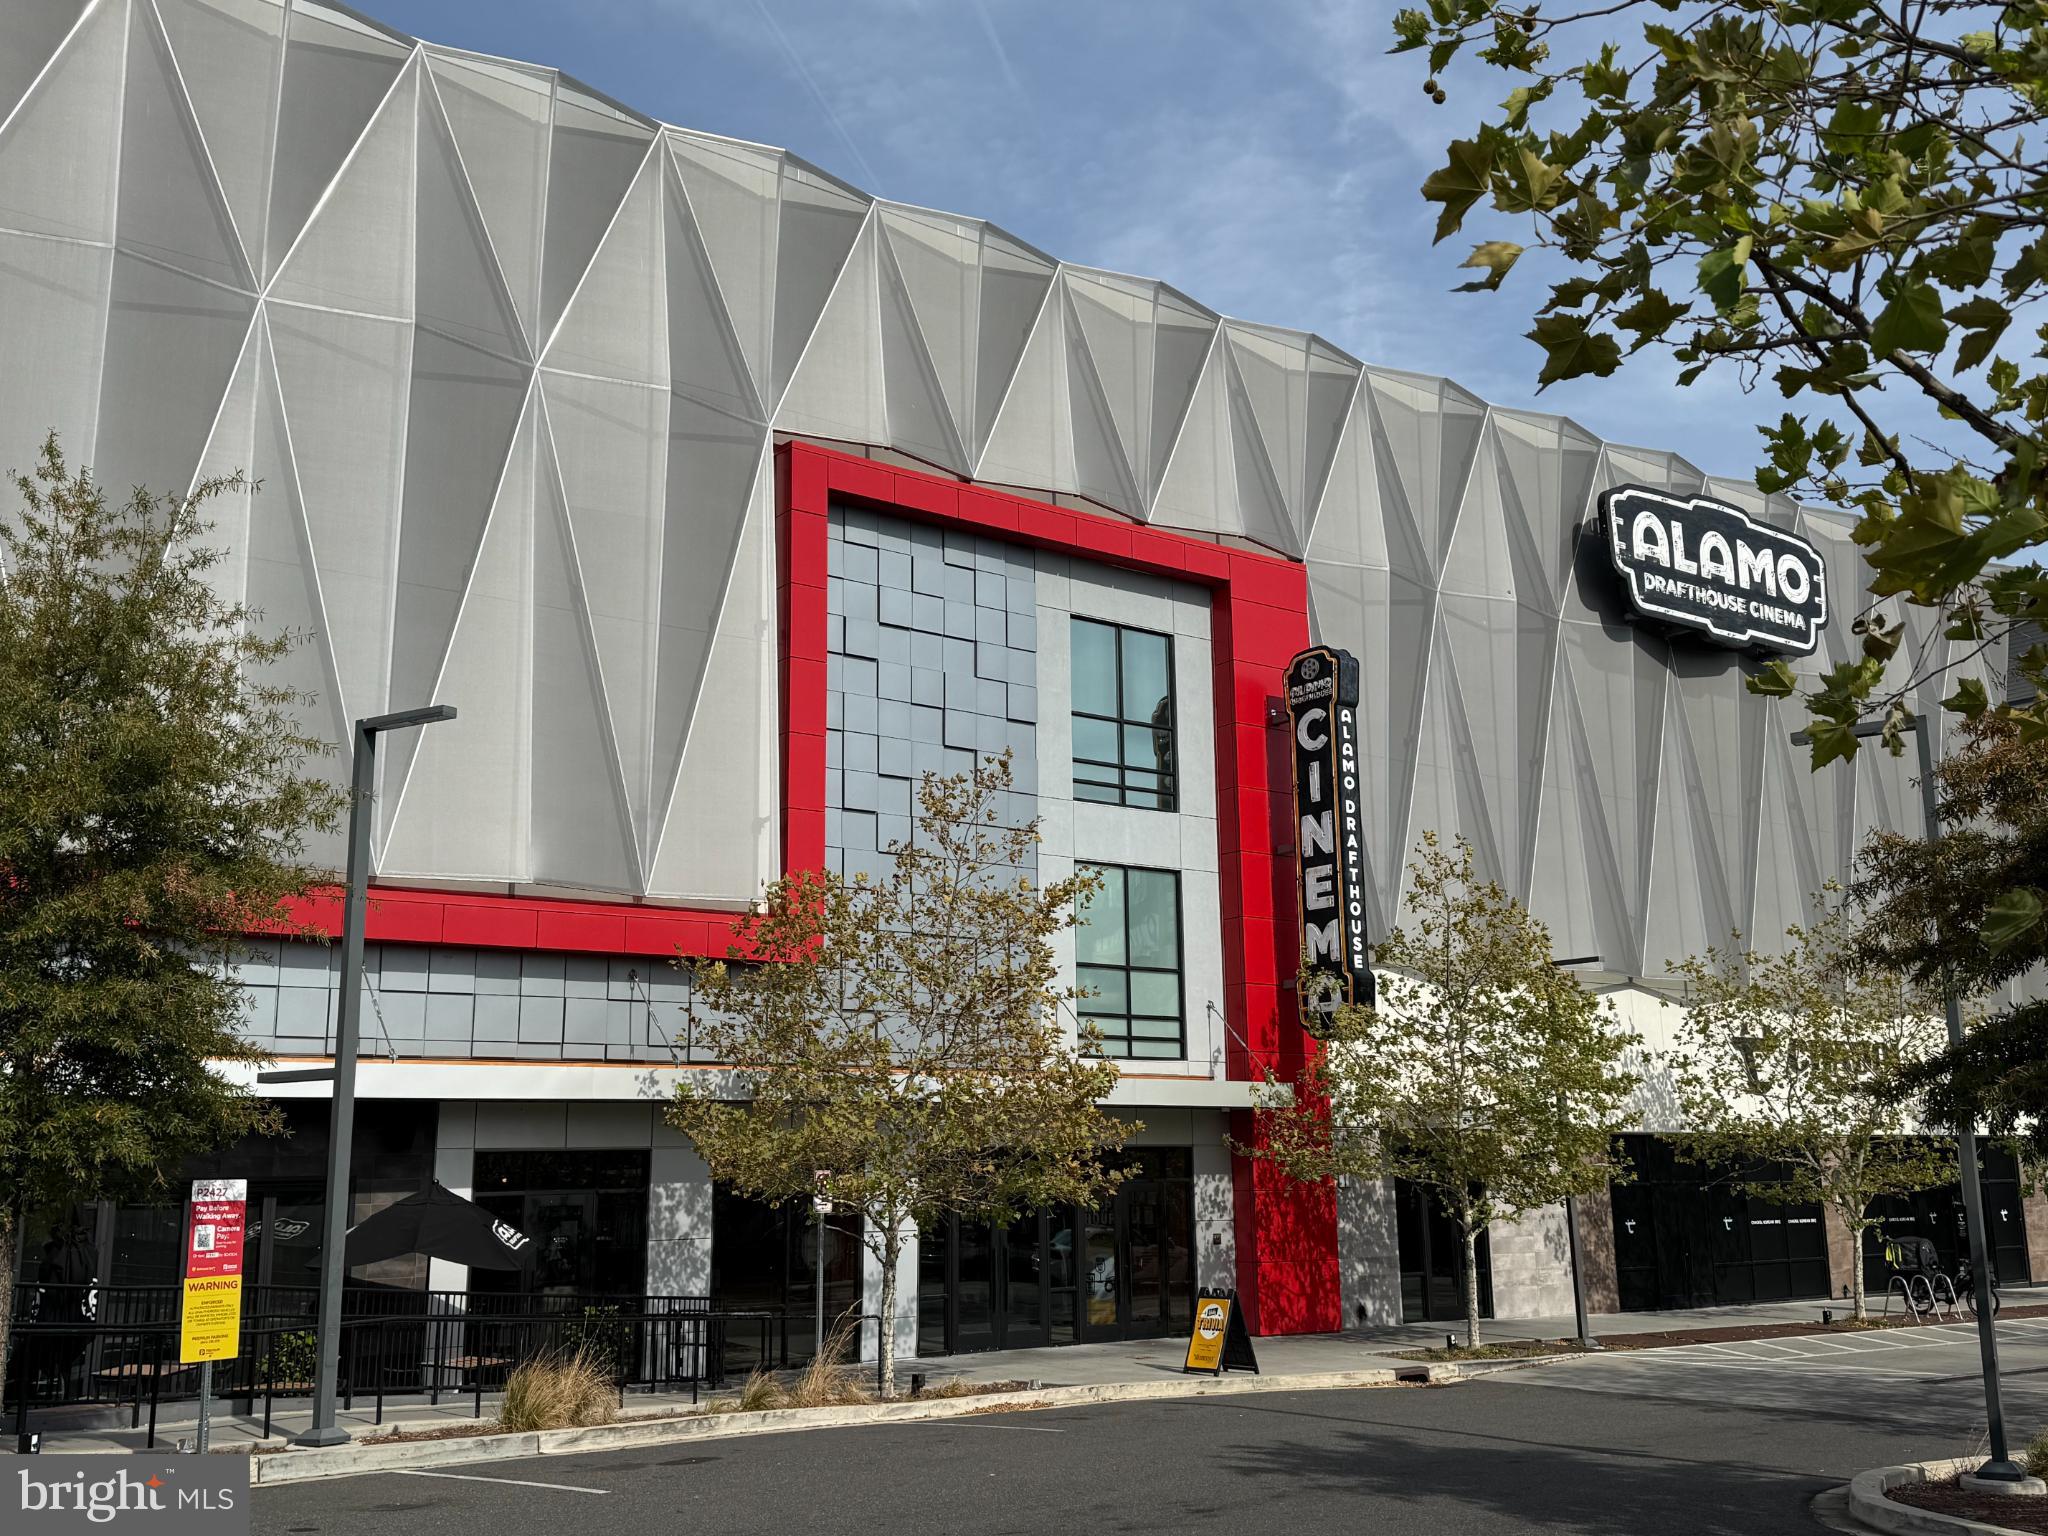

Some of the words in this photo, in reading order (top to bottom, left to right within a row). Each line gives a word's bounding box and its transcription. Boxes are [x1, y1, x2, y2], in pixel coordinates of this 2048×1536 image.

[1632, 510, 1811, 604] ALAMO
[1644, 572, 1748, 614] DRAFTHOUSE
[1749, 602, 1807, 631] CINEMA
[1340, 709, 1355, 790] ALAMO
[1297, 708, 1342, 1027] CINEMA
[1345, 799, 1364, 969] DRAFTHOUSE
[197, 1187, 228, 1198] P2427
[188, 1281, 238, 1292] WARNING
